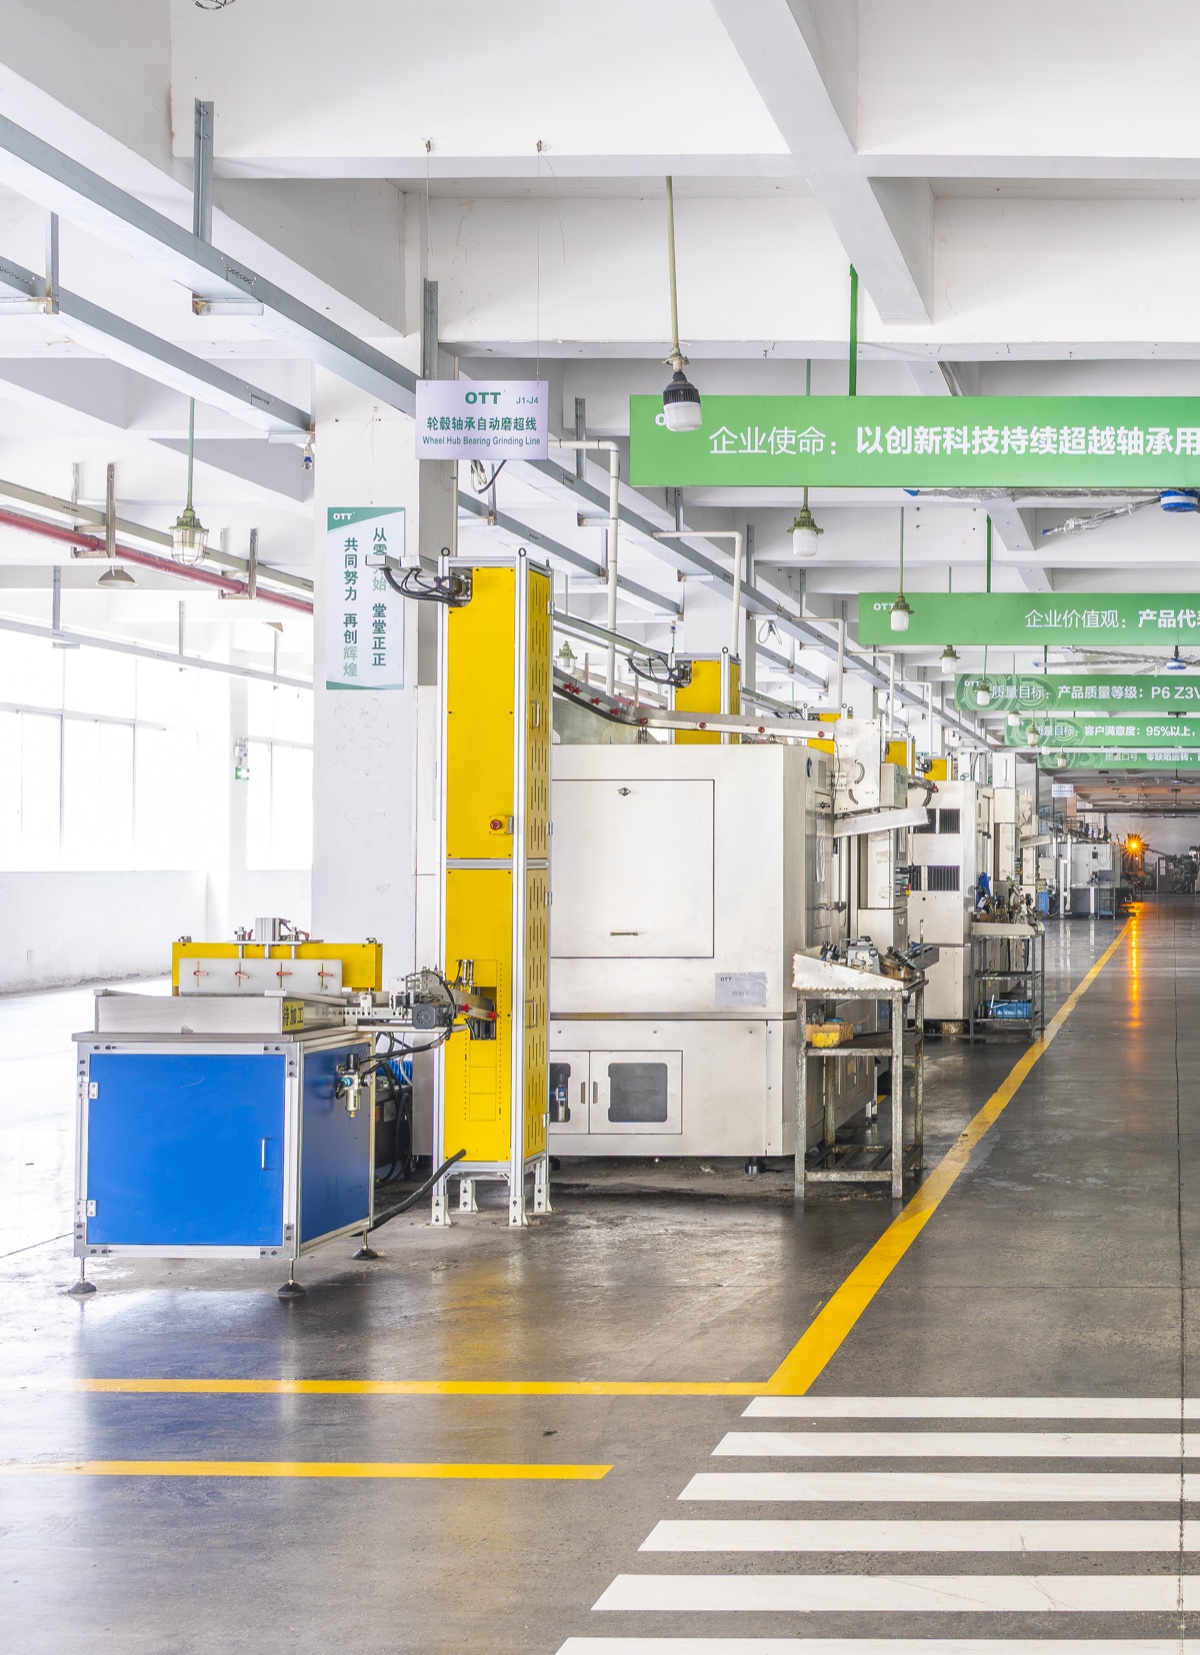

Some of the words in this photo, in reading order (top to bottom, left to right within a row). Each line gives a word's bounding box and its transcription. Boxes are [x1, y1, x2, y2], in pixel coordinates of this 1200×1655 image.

[465, 391, 501, 405] OTT
[516, 396, 539, 405] J1-J4
[423, 436, 445, 445] Wheel
[446, 436, 461, 445] Hub
[463, 436, 491, 447] Bearing
[492, 436, 524, 447] Grinding
[525, 436, 541, 446] Line
[427, 416, 537, 431] 轮毂轴承自动磨超线
[333, 512, 352, 521] OTT
[344, 537, 359, 602] 共同努力
[372, 527, 388, 592] 从零始
[343, 613, 358, 678] 再创辉煌
[372, 602, 387, 667] 堂堂正正
